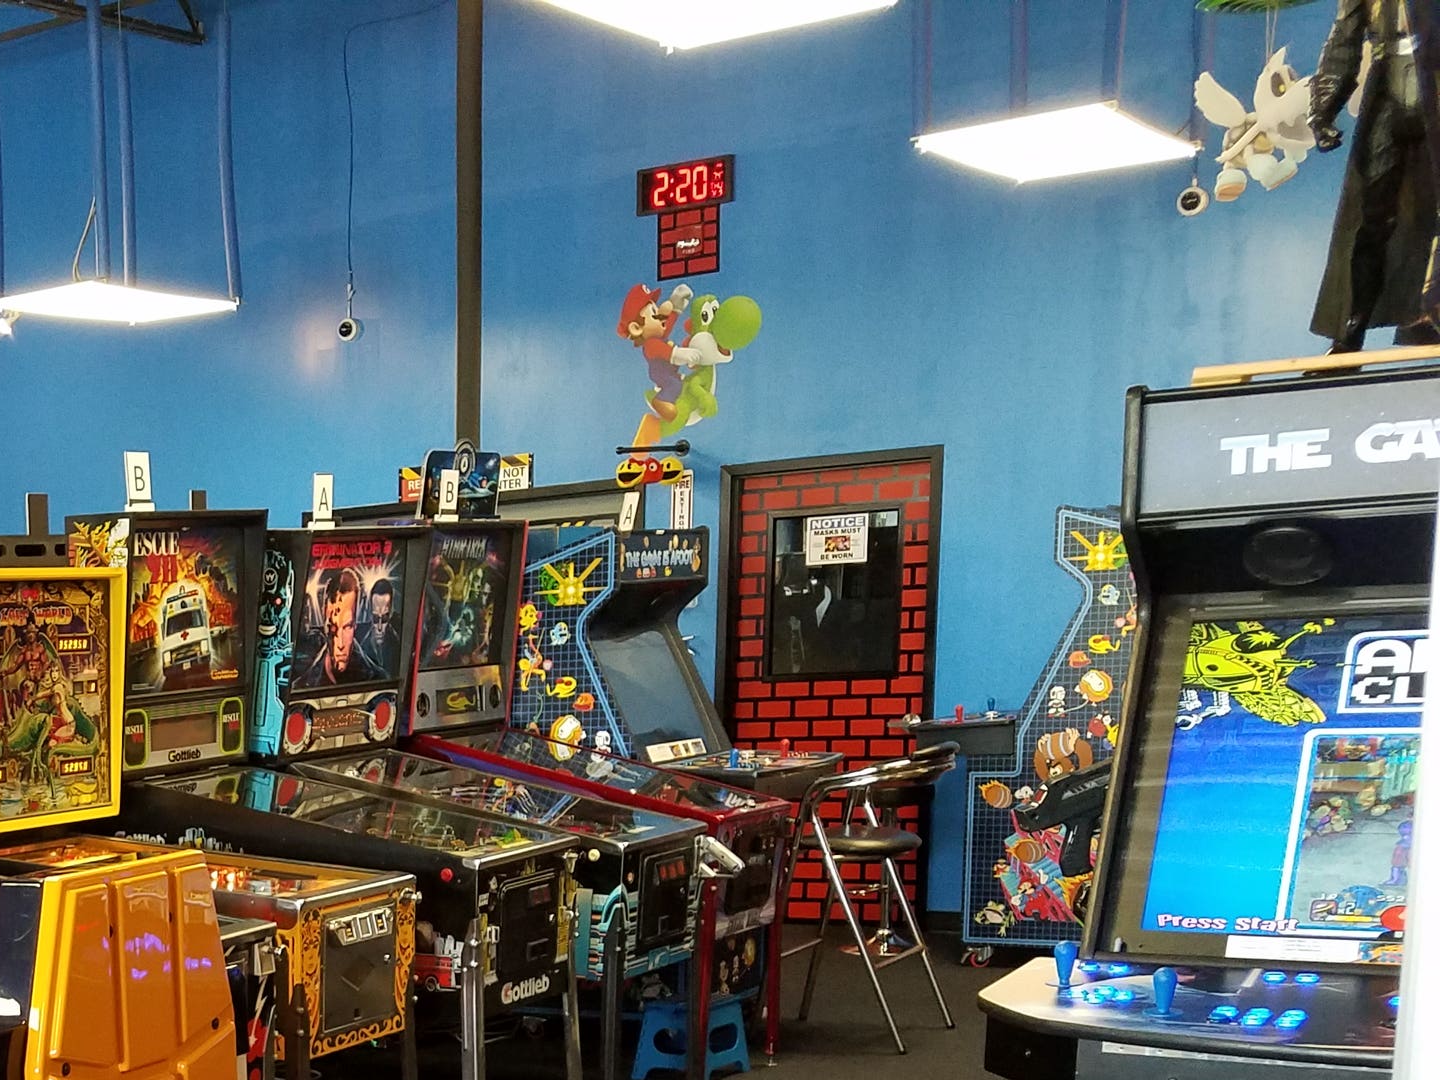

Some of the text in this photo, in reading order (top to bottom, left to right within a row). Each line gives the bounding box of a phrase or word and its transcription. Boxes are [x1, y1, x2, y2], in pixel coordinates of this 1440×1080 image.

[653, 165, 707, 207] 2:20
[1220, 418, 1440, 476] THE GA
[133, 466, 147, 492] B
[503, 466, 525, 479] NOT
[445, 481, 455, 504] B
[499, 478, 521, 490] NTER
[317, 489, 329, 512] A
[623, 503, 634, 525] A
[811, 517, 865, 530] NOTICE
[133, 531, 180, 557] ESCUE
[311, 543, 381, 557] ERMINATOR
[625, 550, 640, 568] THE
[832, 552, 853, 560] WORN
[167, 747, 202, 763] Gottlieb
[1156, 913, 1300, 933] Press Start
[501, 973, 550, 1005] Gottlieb
